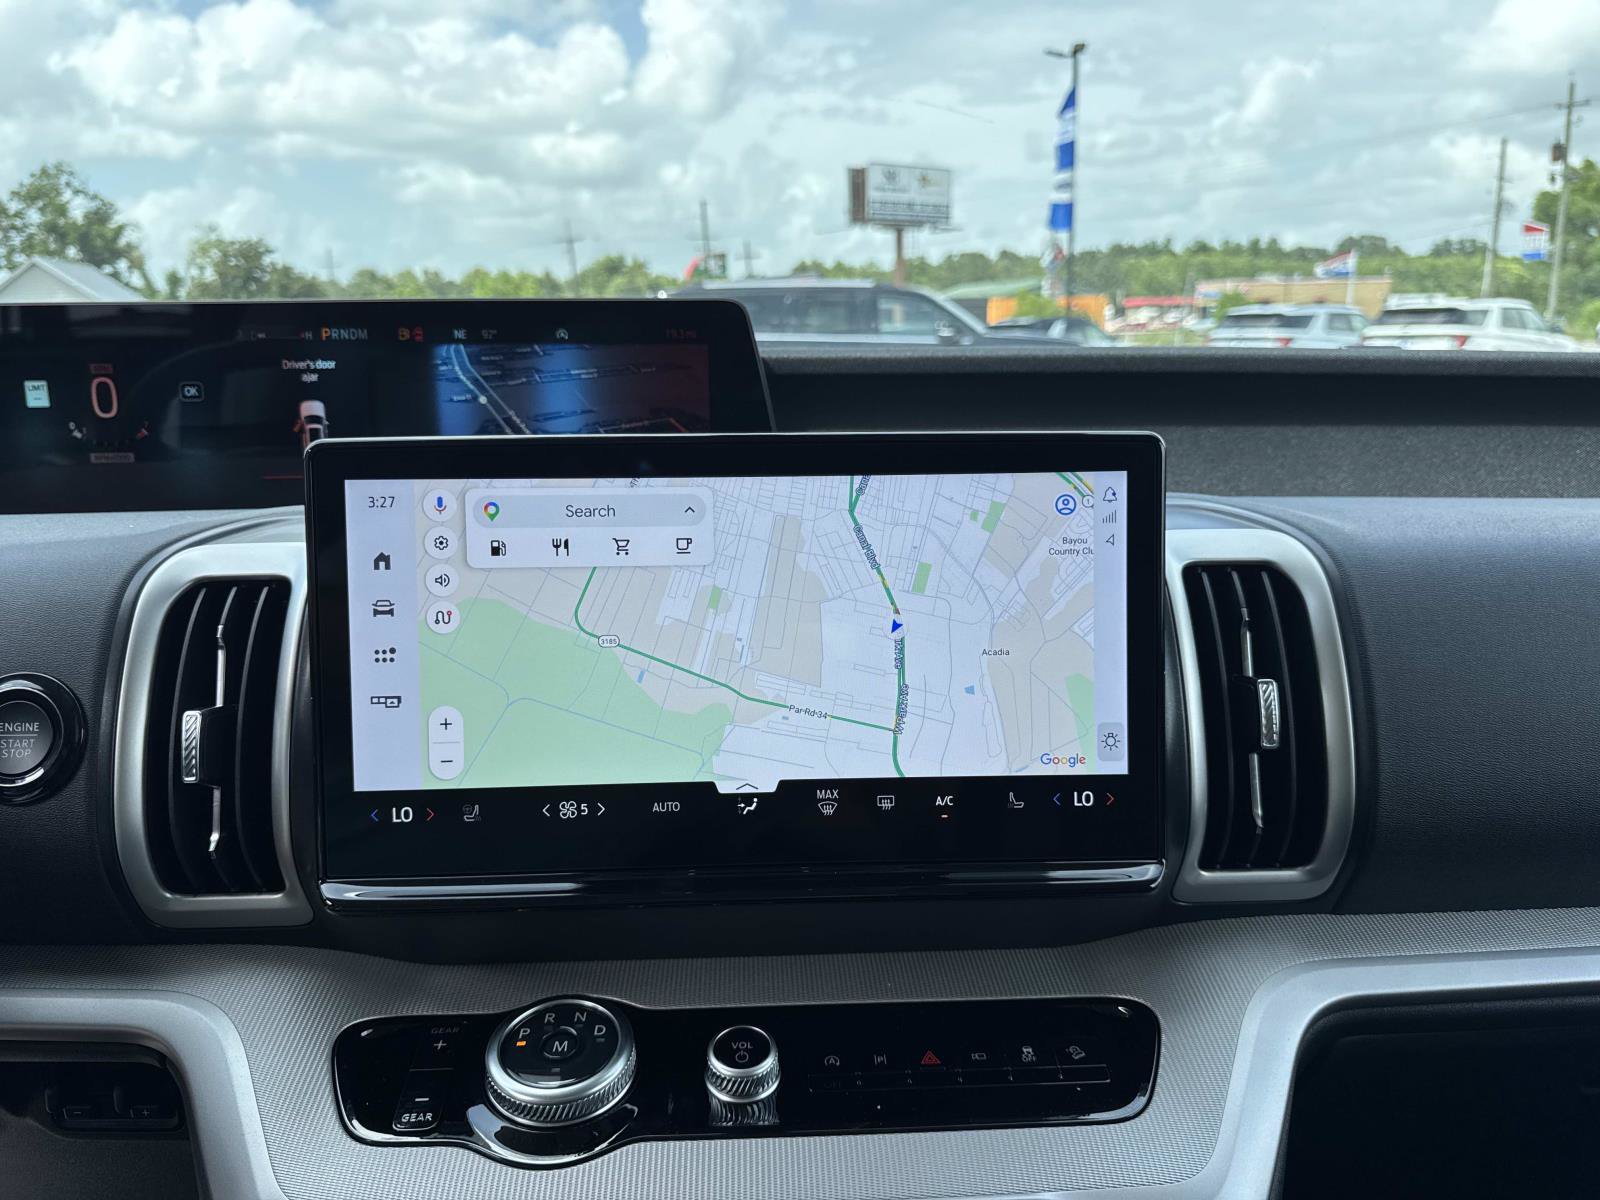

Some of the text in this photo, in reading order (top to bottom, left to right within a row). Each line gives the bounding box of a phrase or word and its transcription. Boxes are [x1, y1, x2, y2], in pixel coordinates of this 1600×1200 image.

[453, 329, 467, 340] NE
[282, 359, 336, 370] Driver's door
[301, 371, 319, 383] ajar
[184, 386, 198, 397] OK
[90, 376, 118, 419] 0
[368, 496, 395, 508] 3:27
[565, 504, 616, 518] Search
[1062, 537, 1088, 546] Bayou
[853, 525, 881, 570] Canal Blvd
[1048, 548, 1080, 557] Country
[981, 647, 1010, 657] Acadia
[898, 683, 909, 701] Ave
[789, 705, 828, 719] Par Rd 34
[895, 701, 908, 723] Park
[0, 722, 40, 732] ENGINE
[0, 739, 35, 748] START
[1, 749, 32, 758] STOP
[1040, 753, 1087, 768] Google
[816, 789, 839, 799] MAX
[1073, 791, 1094, 807] LO
[935, 795, 954, 807] A/C
[580, 803, 589, 815] 5
[652, 801, 681, 813] AUTO
[392, 806, 413, 823] LO
[544, 1012, 555, 1023] R
[574, 1011, 587, 1022] N
[431, 1026, 459, 1034] GEAR
[519, 1028, 530, 1038] P
[594, 1025, 606, 1036] D
[552, 1041, 568, 1052] M
[731, 1041, 754, 1050] VOL
[401, 1112, 433, 1122] GEAR
